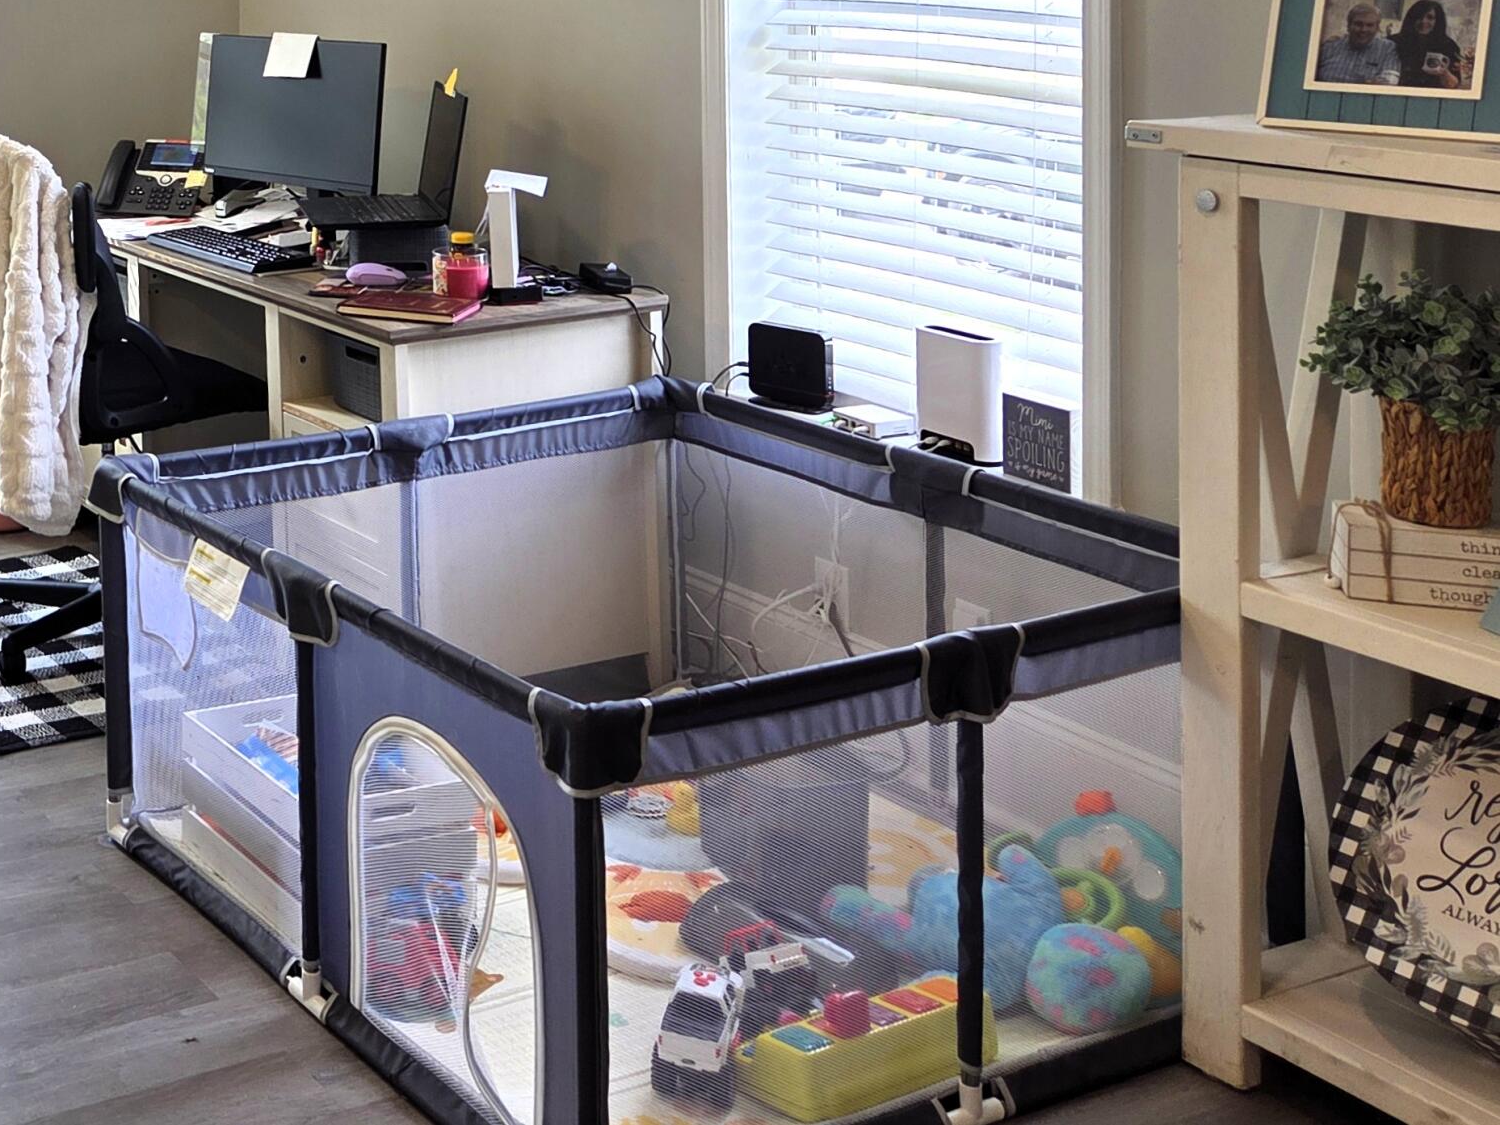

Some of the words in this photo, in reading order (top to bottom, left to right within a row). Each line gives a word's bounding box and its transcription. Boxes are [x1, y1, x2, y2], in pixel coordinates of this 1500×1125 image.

[1017, 403, 1054, 430] Mimi
[1007, 420, 1017, 437] IS
[1019, 425, 1034, 441] MY
[1038, 429, 1064, 451] NAME
[1007, 436, 1065, 473] SPOILING
